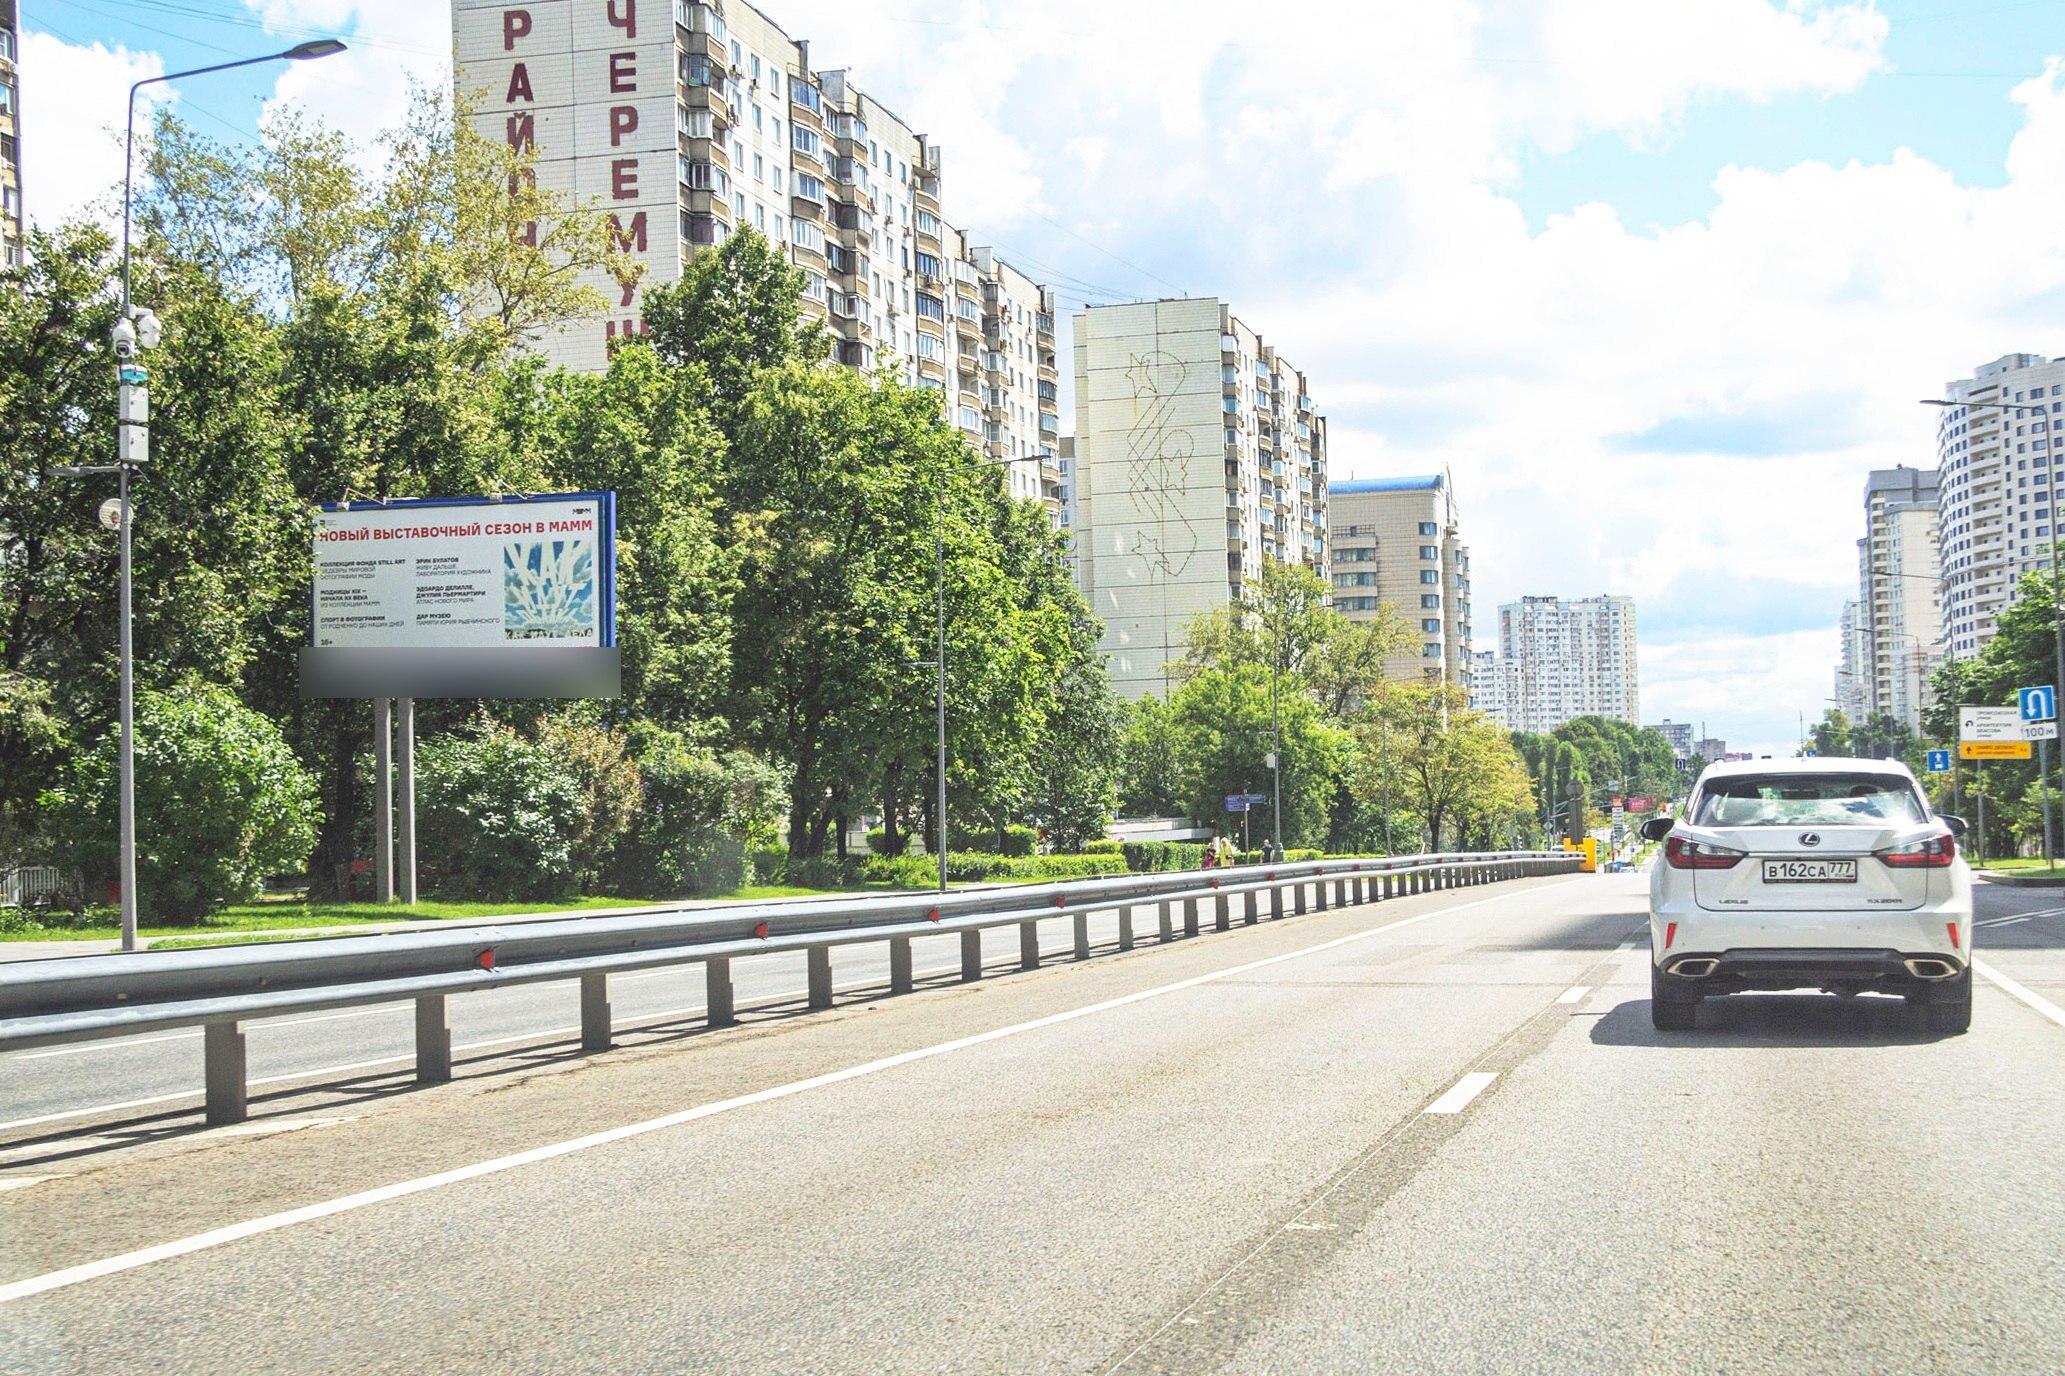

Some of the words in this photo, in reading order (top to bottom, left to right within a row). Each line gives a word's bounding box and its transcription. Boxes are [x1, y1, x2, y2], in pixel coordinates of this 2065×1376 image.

[320, 528, 369, 542] НОВЫЙ
[374, 522, 480, 540] ВЫСТАВОЧНЫЙ
[485, 522, 531, 535] СЕЗОН
[536, 522, 544, 532] В
[549, 520, 592, 532] МАММ
[2025, 727, 2044, 737] 100
[1830, 862, 1851, 873] 777
